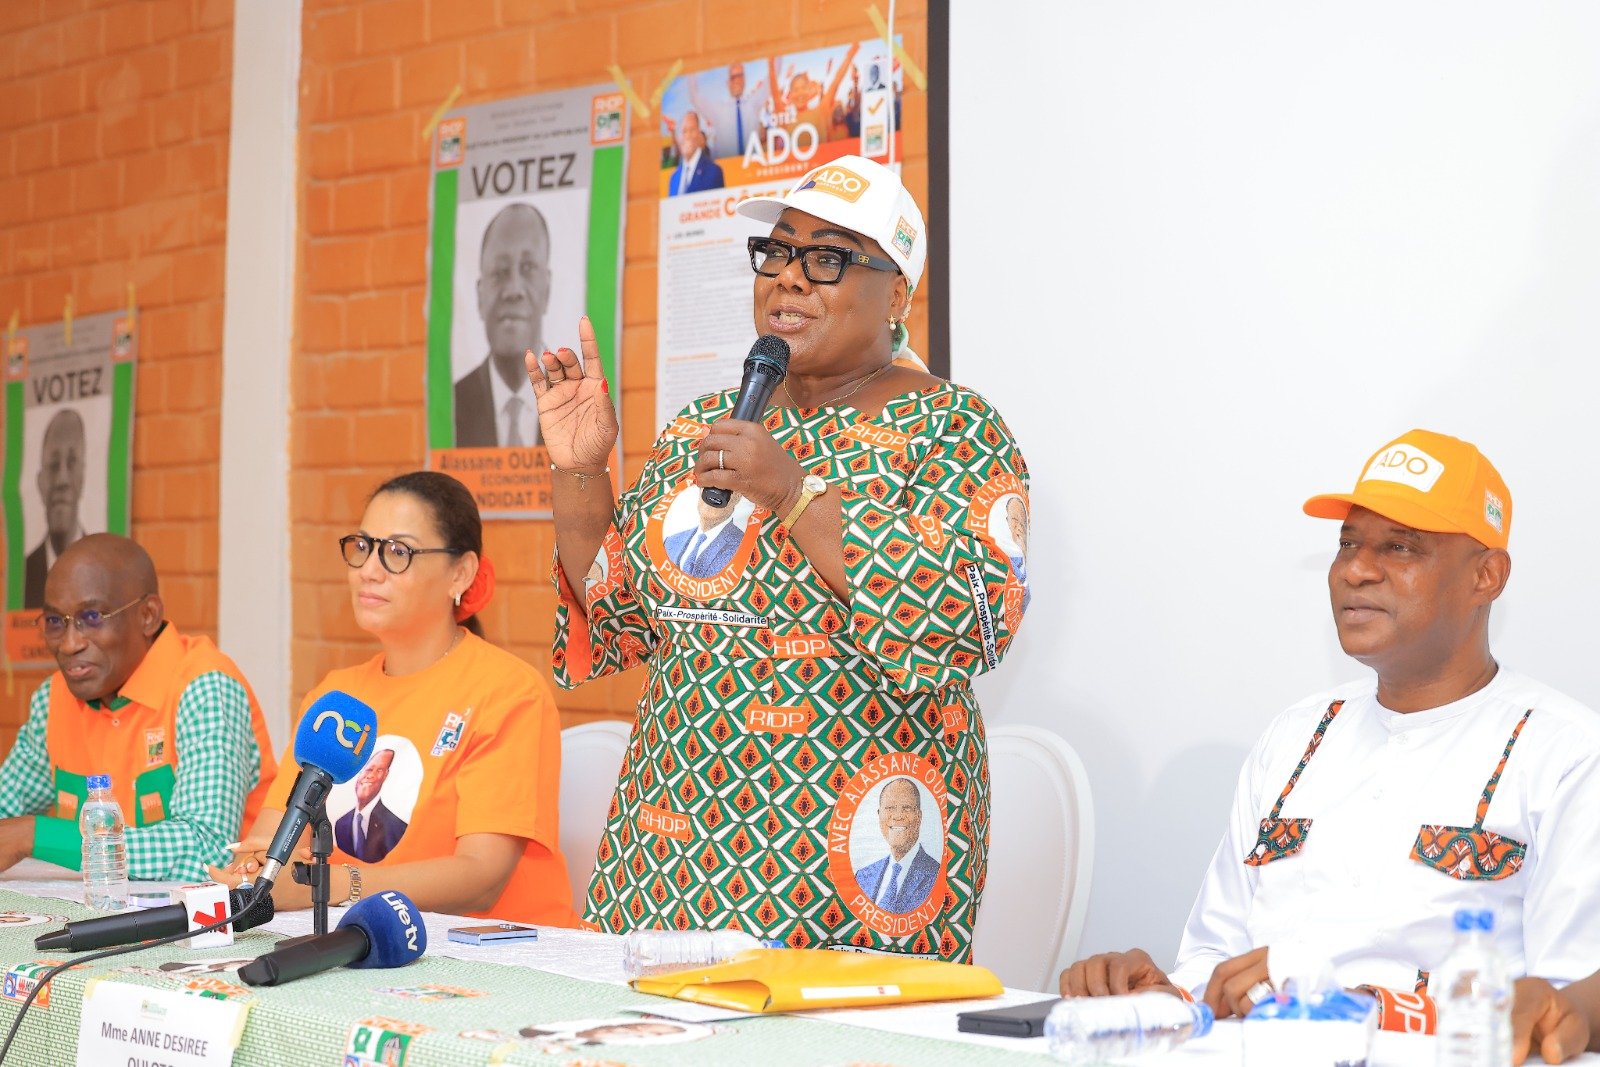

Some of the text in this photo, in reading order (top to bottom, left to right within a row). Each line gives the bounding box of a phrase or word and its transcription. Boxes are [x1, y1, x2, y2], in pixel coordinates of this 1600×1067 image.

[742, 122, 819, 169] ADO
[472, 153, 577, 198] VOTEZ
[815, 170, 861, 193] ADO
[33, 366, 104, 405] VOTEZ
[846, 422, 907, 448] RHDP
[1374, 450, 1429, 475] ADO
[656, 489, 682, 521] AVEC
[659, 560, 739, 598] PRESIDENT
[846, 755, 920, 805] ALASSANE
[640, 808, 687, 834] RHDP
[831, 809, 852, 853] AVEC
[850, 894, 936, 934] PRESIDENT
[101, 1021, 209, 1057] Mme ANNE DESIREE
